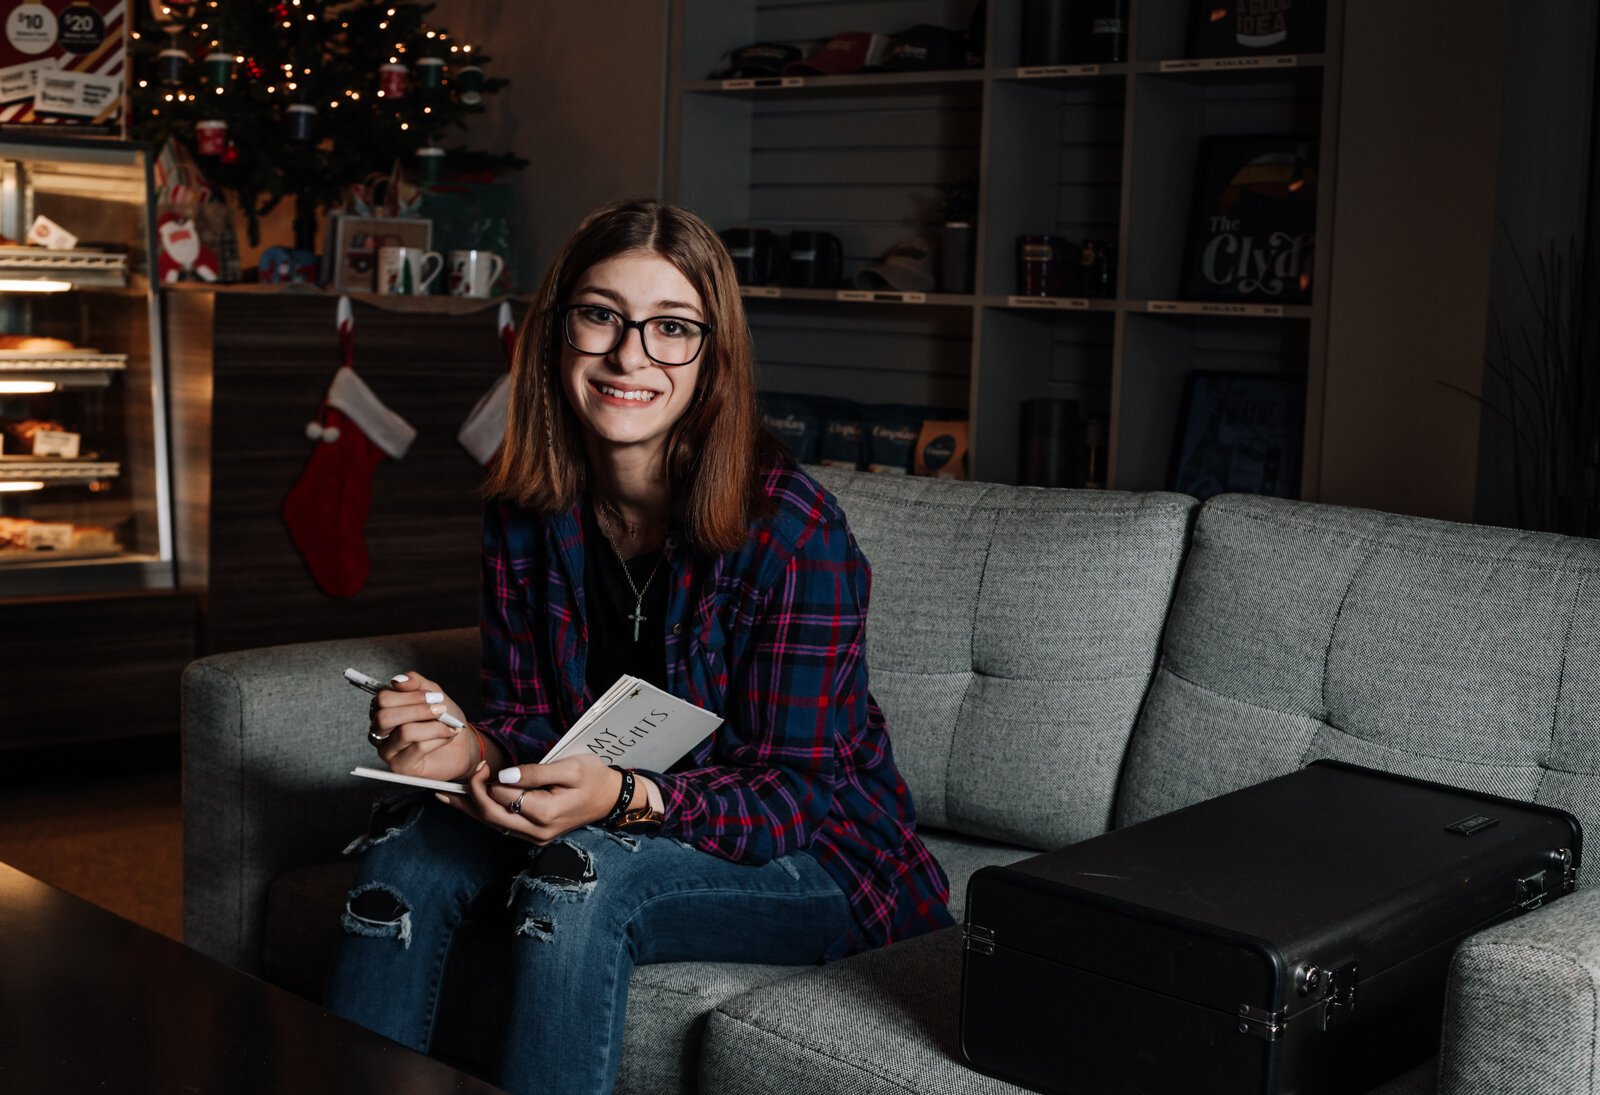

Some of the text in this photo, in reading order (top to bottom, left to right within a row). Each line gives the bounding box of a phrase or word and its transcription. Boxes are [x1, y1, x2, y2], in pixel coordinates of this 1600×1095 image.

[18, 13, 43, 30] $10
[64, 14, 94, 32] $20
[1237, 13, 1287, 35] IDEA
[1208, 215, 1241, 233] The
[1201, 231, 1312, 296] Clyd
[586, 727, 618, 755] MY
